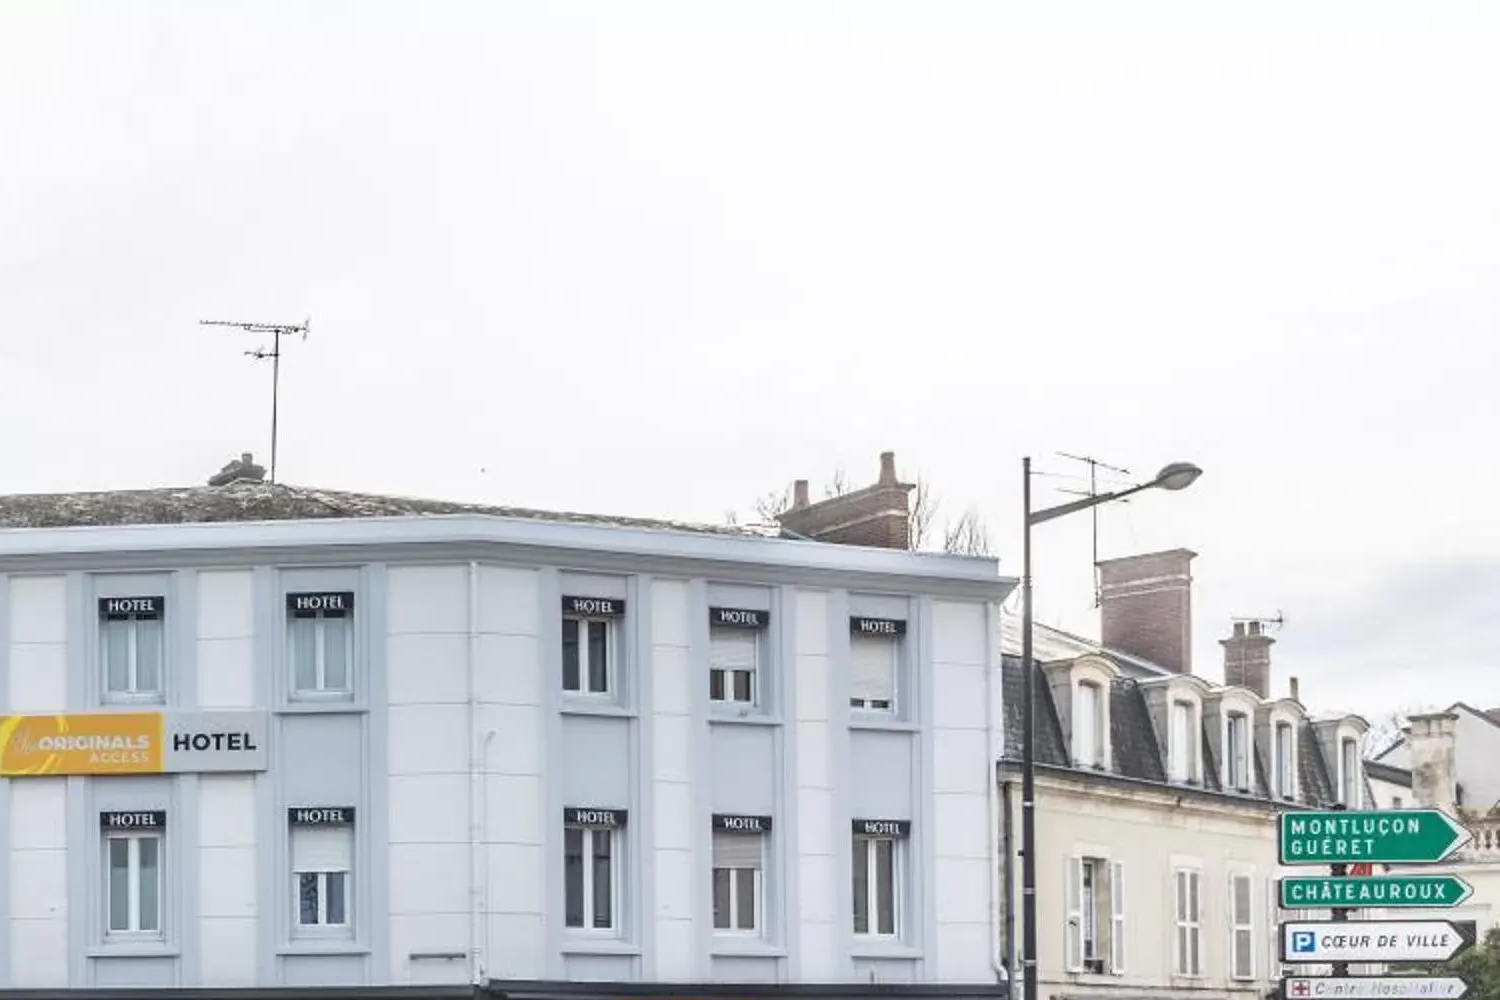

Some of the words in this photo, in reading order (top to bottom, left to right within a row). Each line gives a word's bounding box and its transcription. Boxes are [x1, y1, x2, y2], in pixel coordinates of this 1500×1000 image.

[108, 599, 155, 612] HOTEL
[297, 595, 345, 609] HOTEL
[573, 599, 613, 612] HOTEL
[720, 610, 760, 625] HOTEL
[860, 619, 898, 633] HOTEL
[38, 734, 149, 750] ORIGINALS
[172, 732, 257, 751] HOTEL
[89, 752, 149, 763] ACCESS
[110, 813, 156, 826] HOTEL
[297, 809, 344, 823] HOTEL
[577, 810, 615, 824] HOTEL
[724, 816, 763, 829] HOTEL
[865, 821, 900, 835] HOTEL
[1291, 818, 1420, 838] MONTLUÇON
[1291, 836, 1375, 855] GUÉRET
[1291, 882, 1446, 900] CHÂTEAUROUX
[1377, 935, 1397, 948] DE
[1406, 933, 1449, 948] VILLE
[1315, 981, 1365, 995] Cntr
